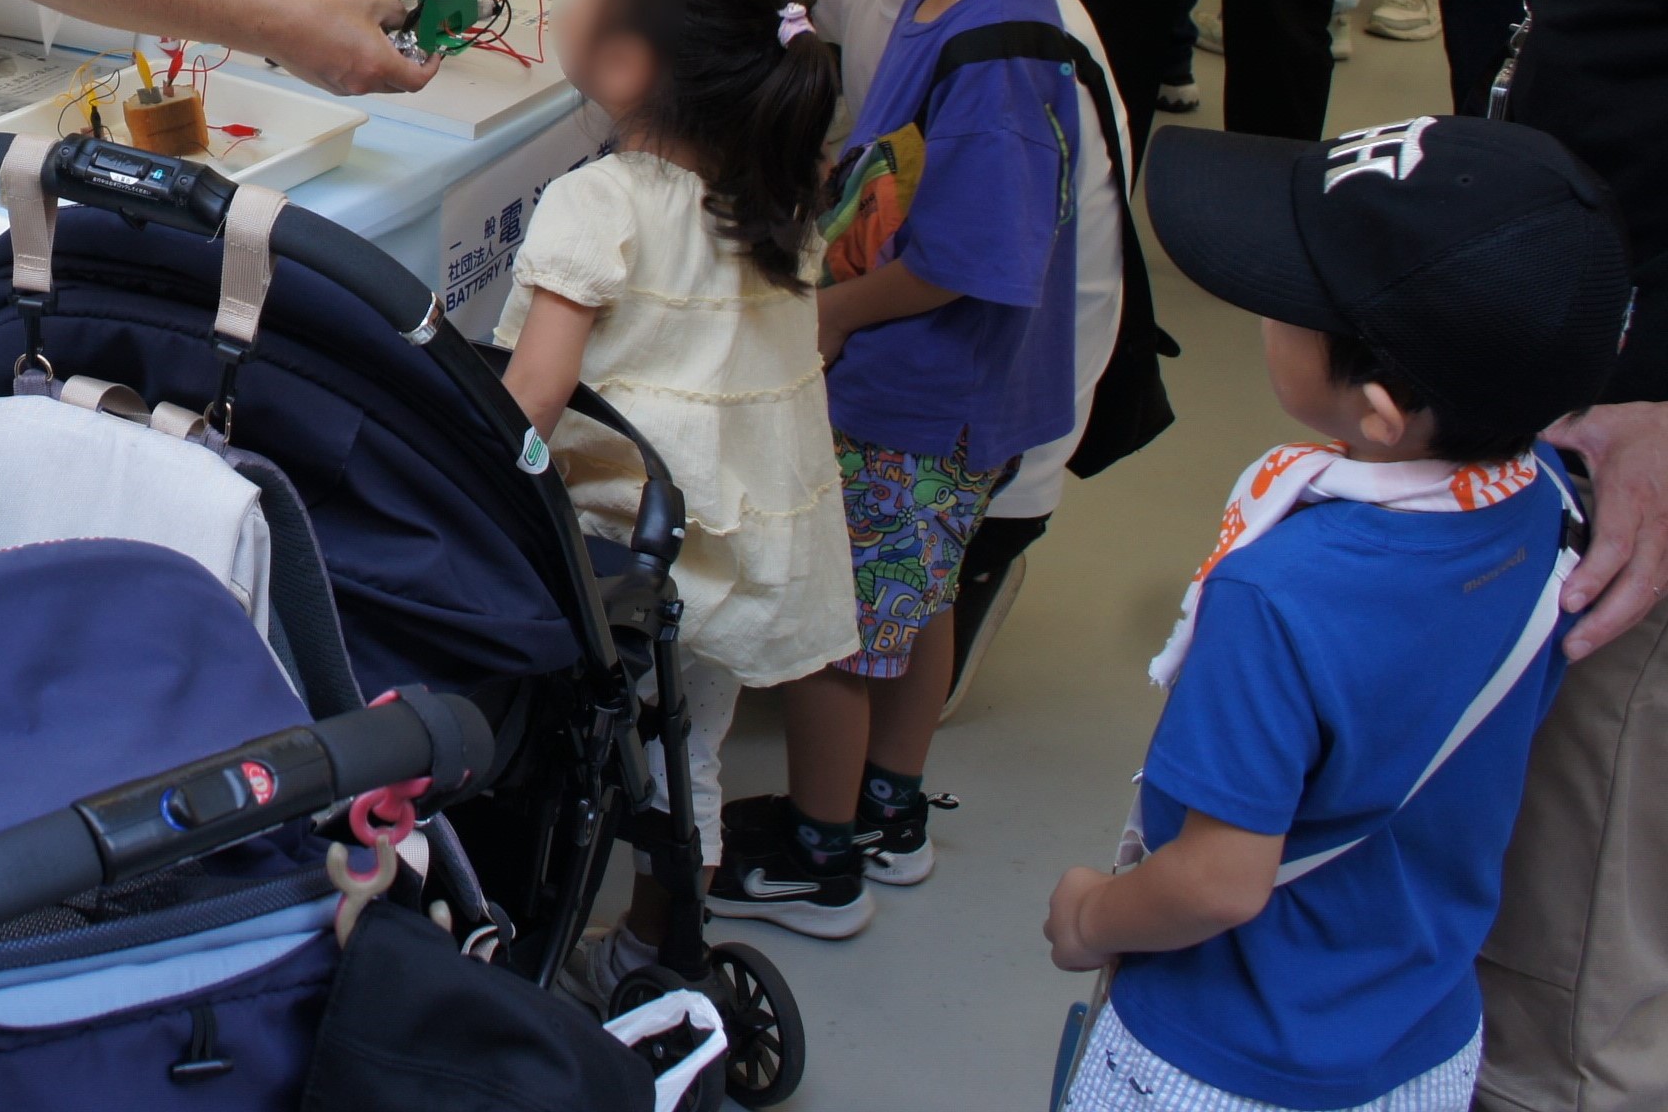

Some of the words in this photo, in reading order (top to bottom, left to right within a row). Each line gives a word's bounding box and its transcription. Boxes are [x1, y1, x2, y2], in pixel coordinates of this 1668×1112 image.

[448, 240, 494, 282] 社団法人
[446, 259, 502, 313] BATTERY
